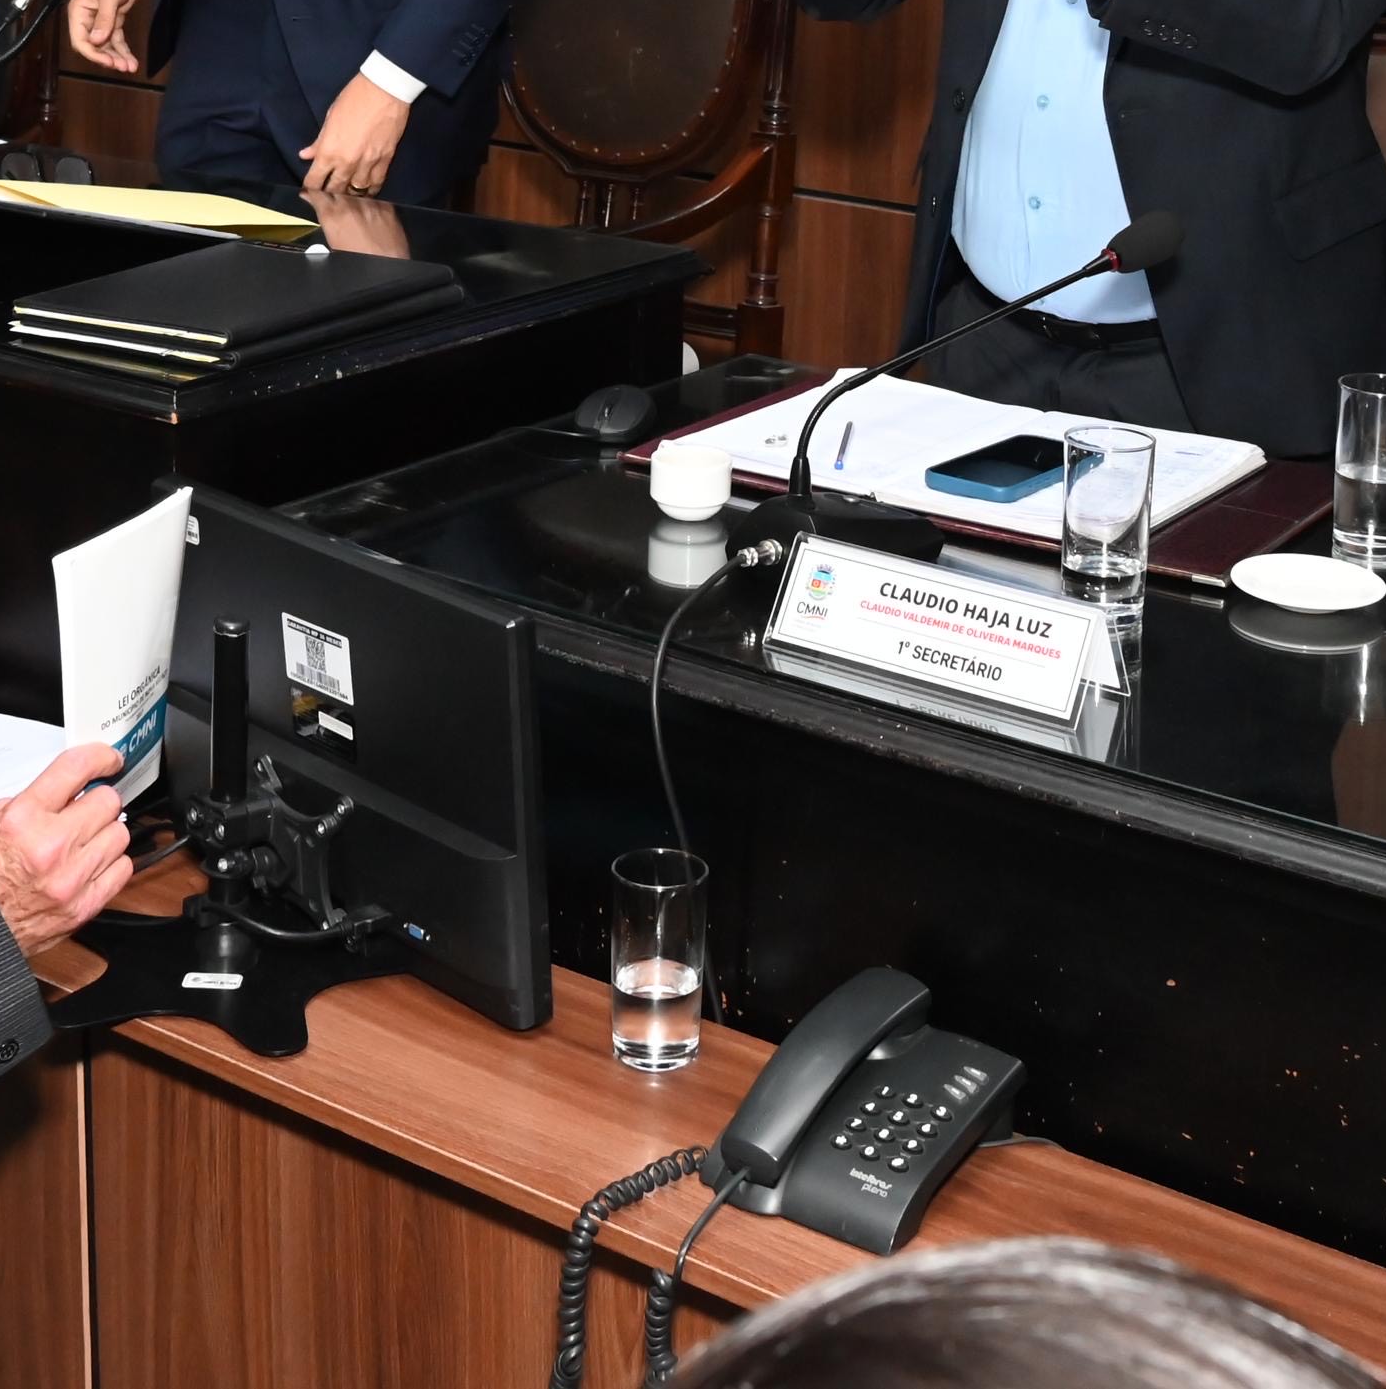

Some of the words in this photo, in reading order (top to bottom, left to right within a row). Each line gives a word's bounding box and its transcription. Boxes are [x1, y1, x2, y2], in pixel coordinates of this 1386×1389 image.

[796, 602, 828, 618] CMNI
[860, 600, 901, 618] CLAUDIO
[903, 611, 951, 631] VALDEMIR
[952, 624, 964, 635] DE
[966, 627, 1011, 647] OLIVEIRA
[1012, 639, 1062, 660] MARQUES
[880, 582, 959, 614] CLAUDIO
[963, 603, 1010, 628] HAJA
[1015, 616, 1053, 638] LUZ
[912, 645, 1003, 681] SECRETÁRIO
[128, 709, 158, 753] CMNI
